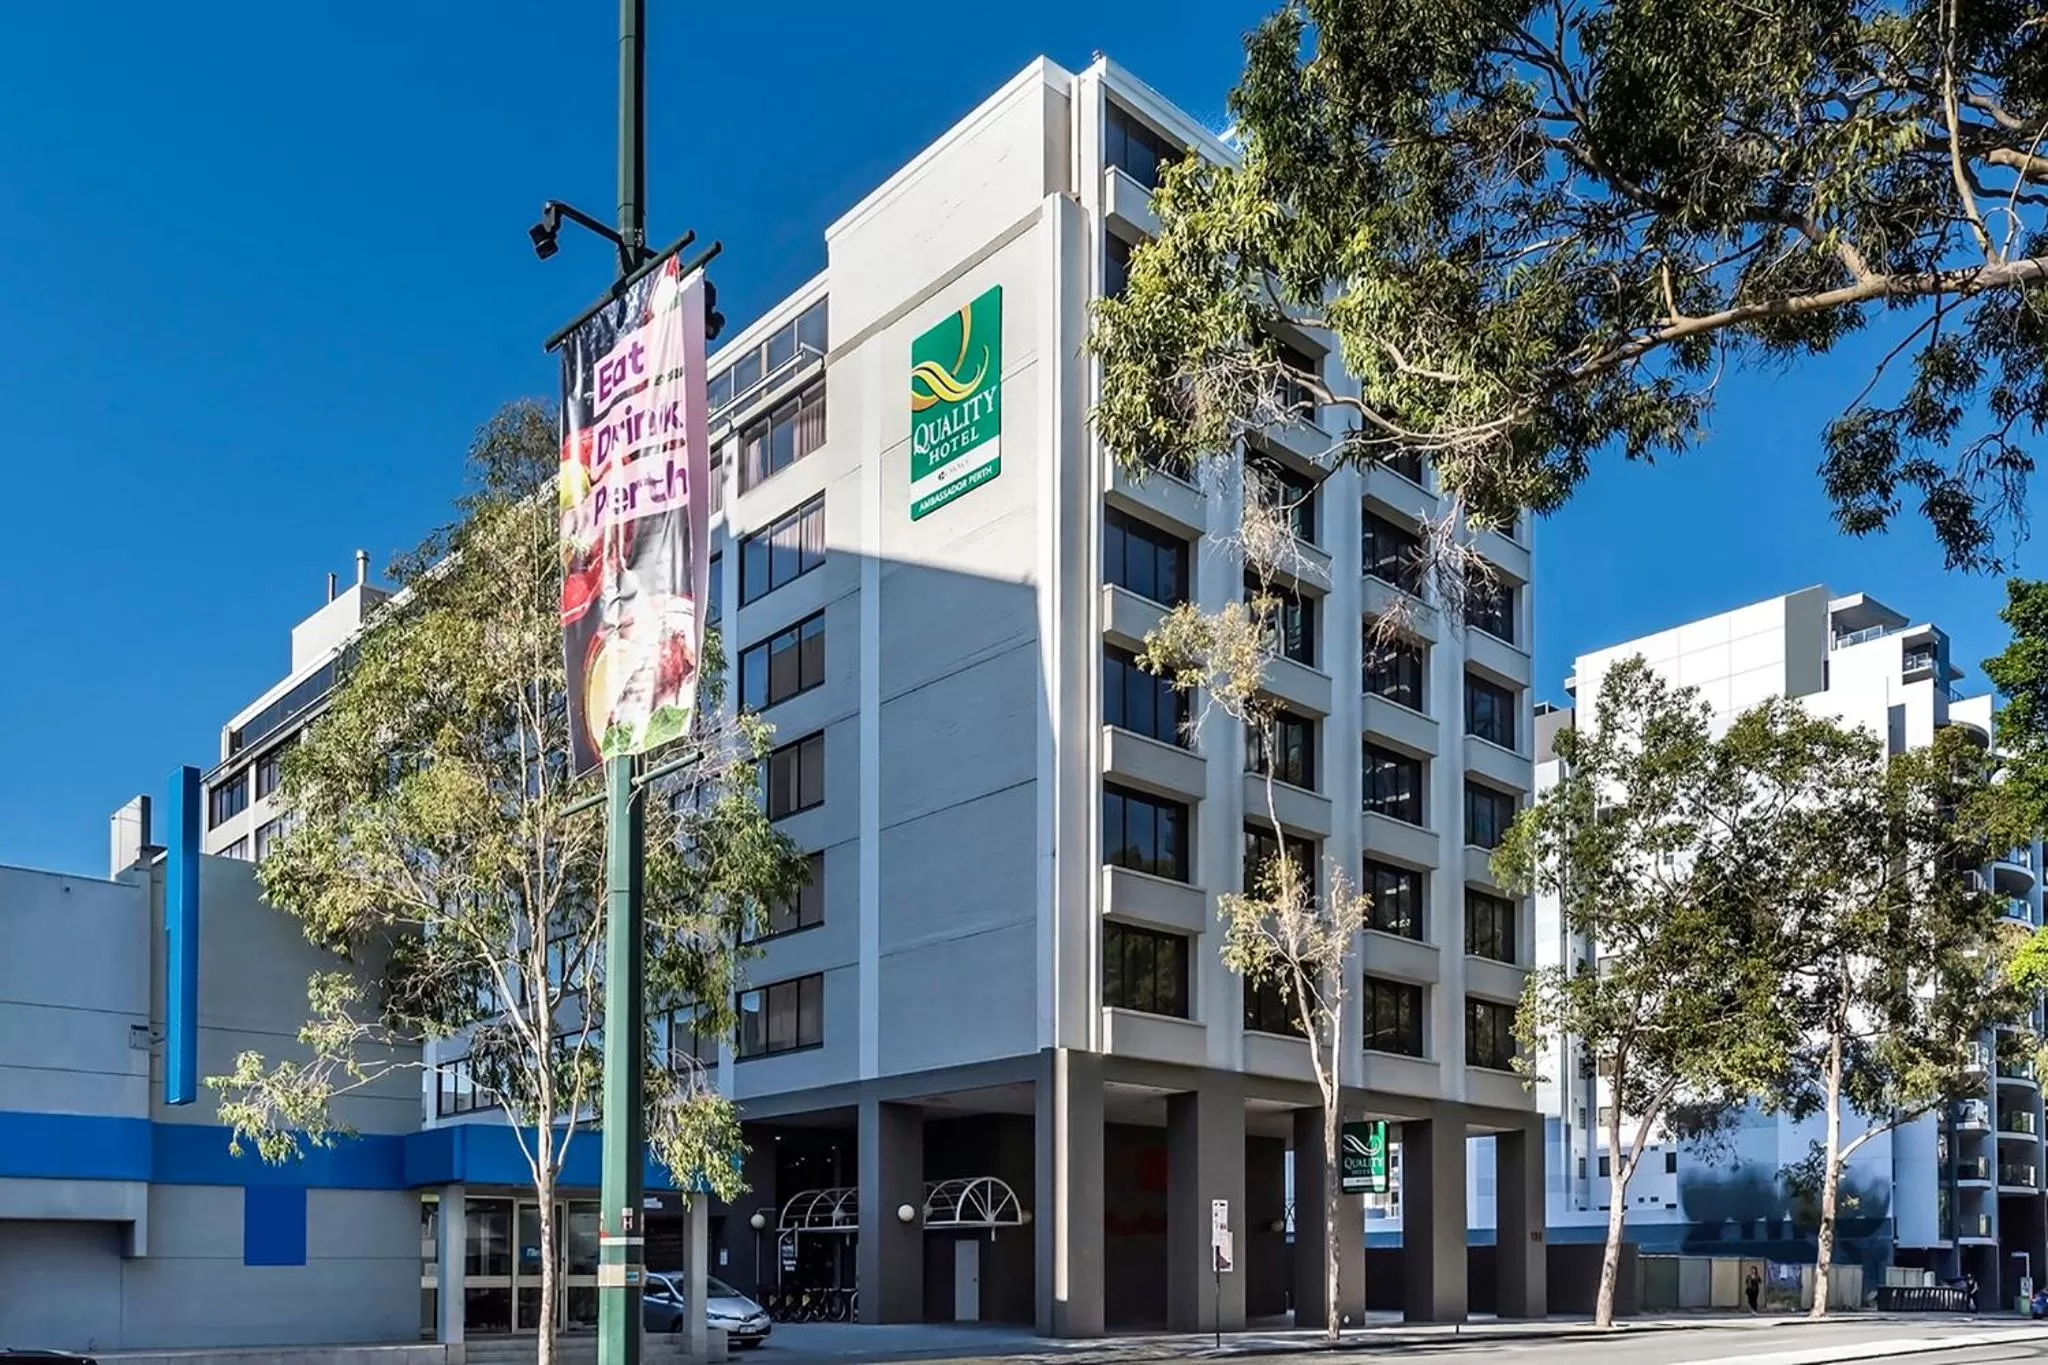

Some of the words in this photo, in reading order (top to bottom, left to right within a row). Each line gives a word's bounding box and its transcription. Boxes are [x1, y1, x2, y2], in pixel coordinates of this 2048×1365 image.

[598, 341, 645, 404] Eat
[597, 401, 684, 466] Drink
[913, 385, 997, 456] QUALITY
[928, 426, 980, 466] HOTEL
[594, 460, 688, 527] Perth
[918, 479, 968, 513] AMBASSADOR
[967, 465, 993, 485] PERTH
